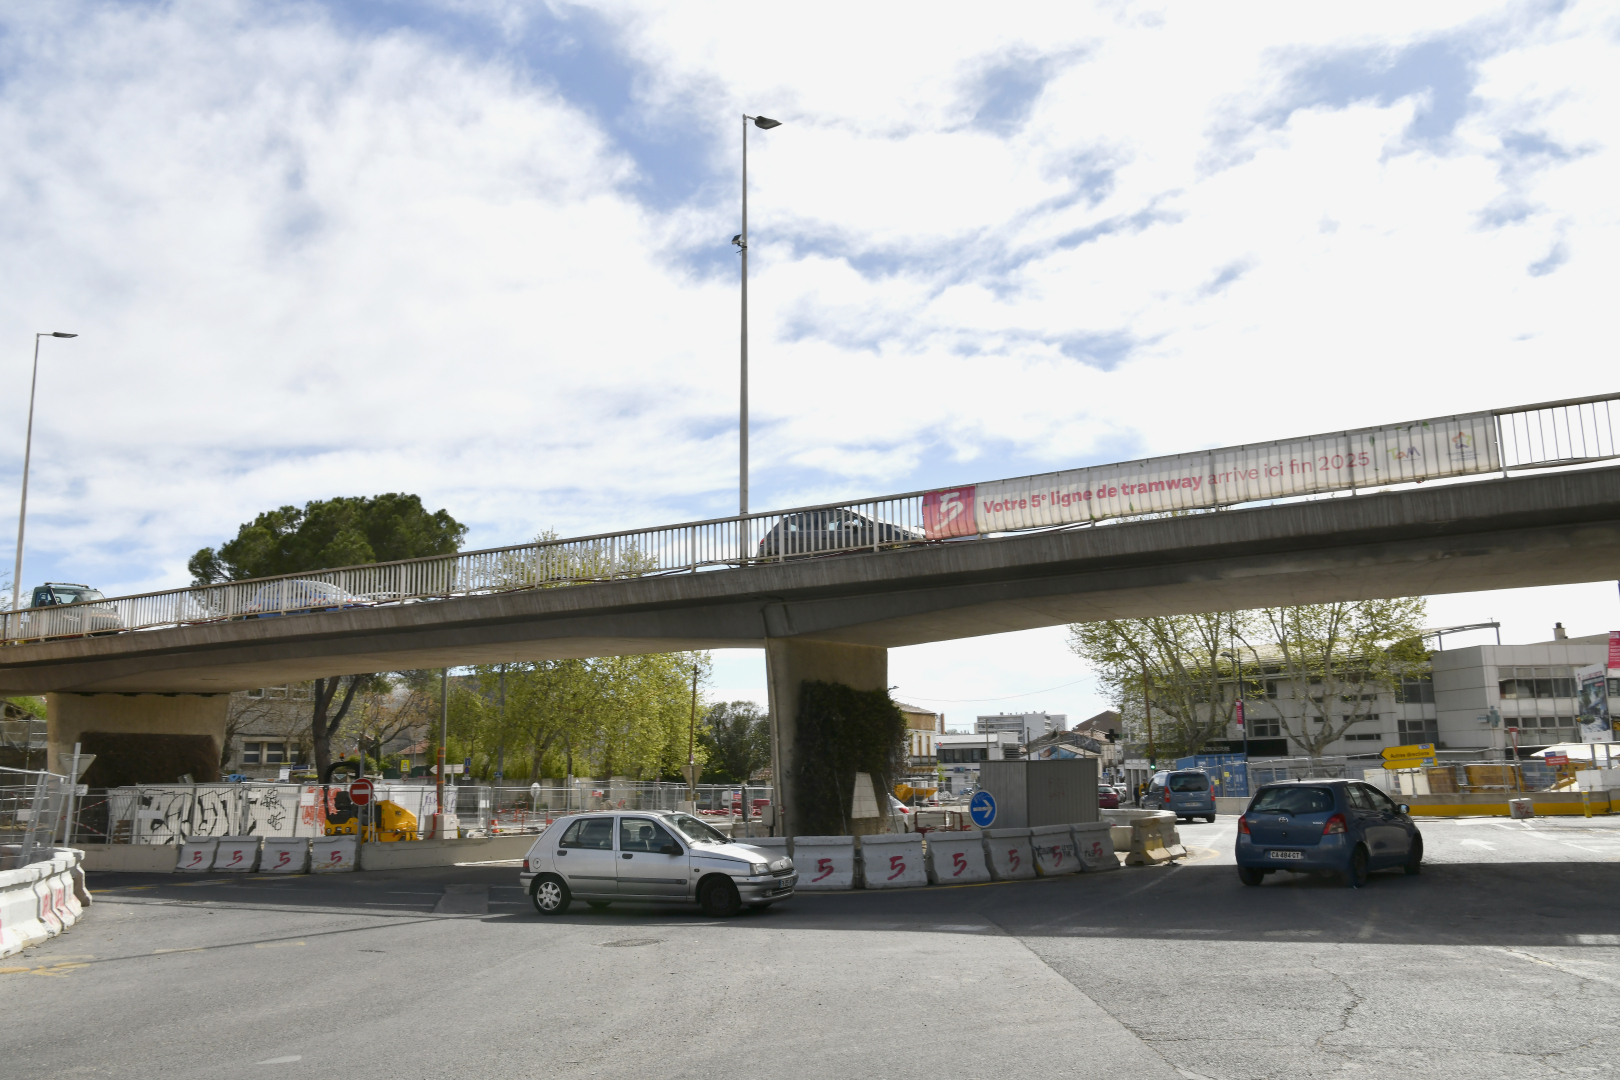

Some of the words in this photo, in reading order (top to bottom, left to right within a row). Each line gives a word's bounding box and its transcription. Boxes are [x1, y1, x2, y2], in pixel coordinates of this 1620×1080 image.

[983, 498, 1027, 514] Votre
[1050, 490, 1093, 508] ligne
[1096, 484, 1118, 499] de
[1120, 475, 1202, 496] tramway
[1208, 467, 1259, 485] arrive
[1263, 461, 1284, 478] ici
[1289, 458, 1313, 475] fin
[1318, 451, 1370, 471] 2025
[934, 491, 964, 531] 5
[811, 858, 834, 882] 5
[887, 856, 906, 881] 5
[952, 853, 967, 876] 5
[1008, 849, 1020, 872] 5
